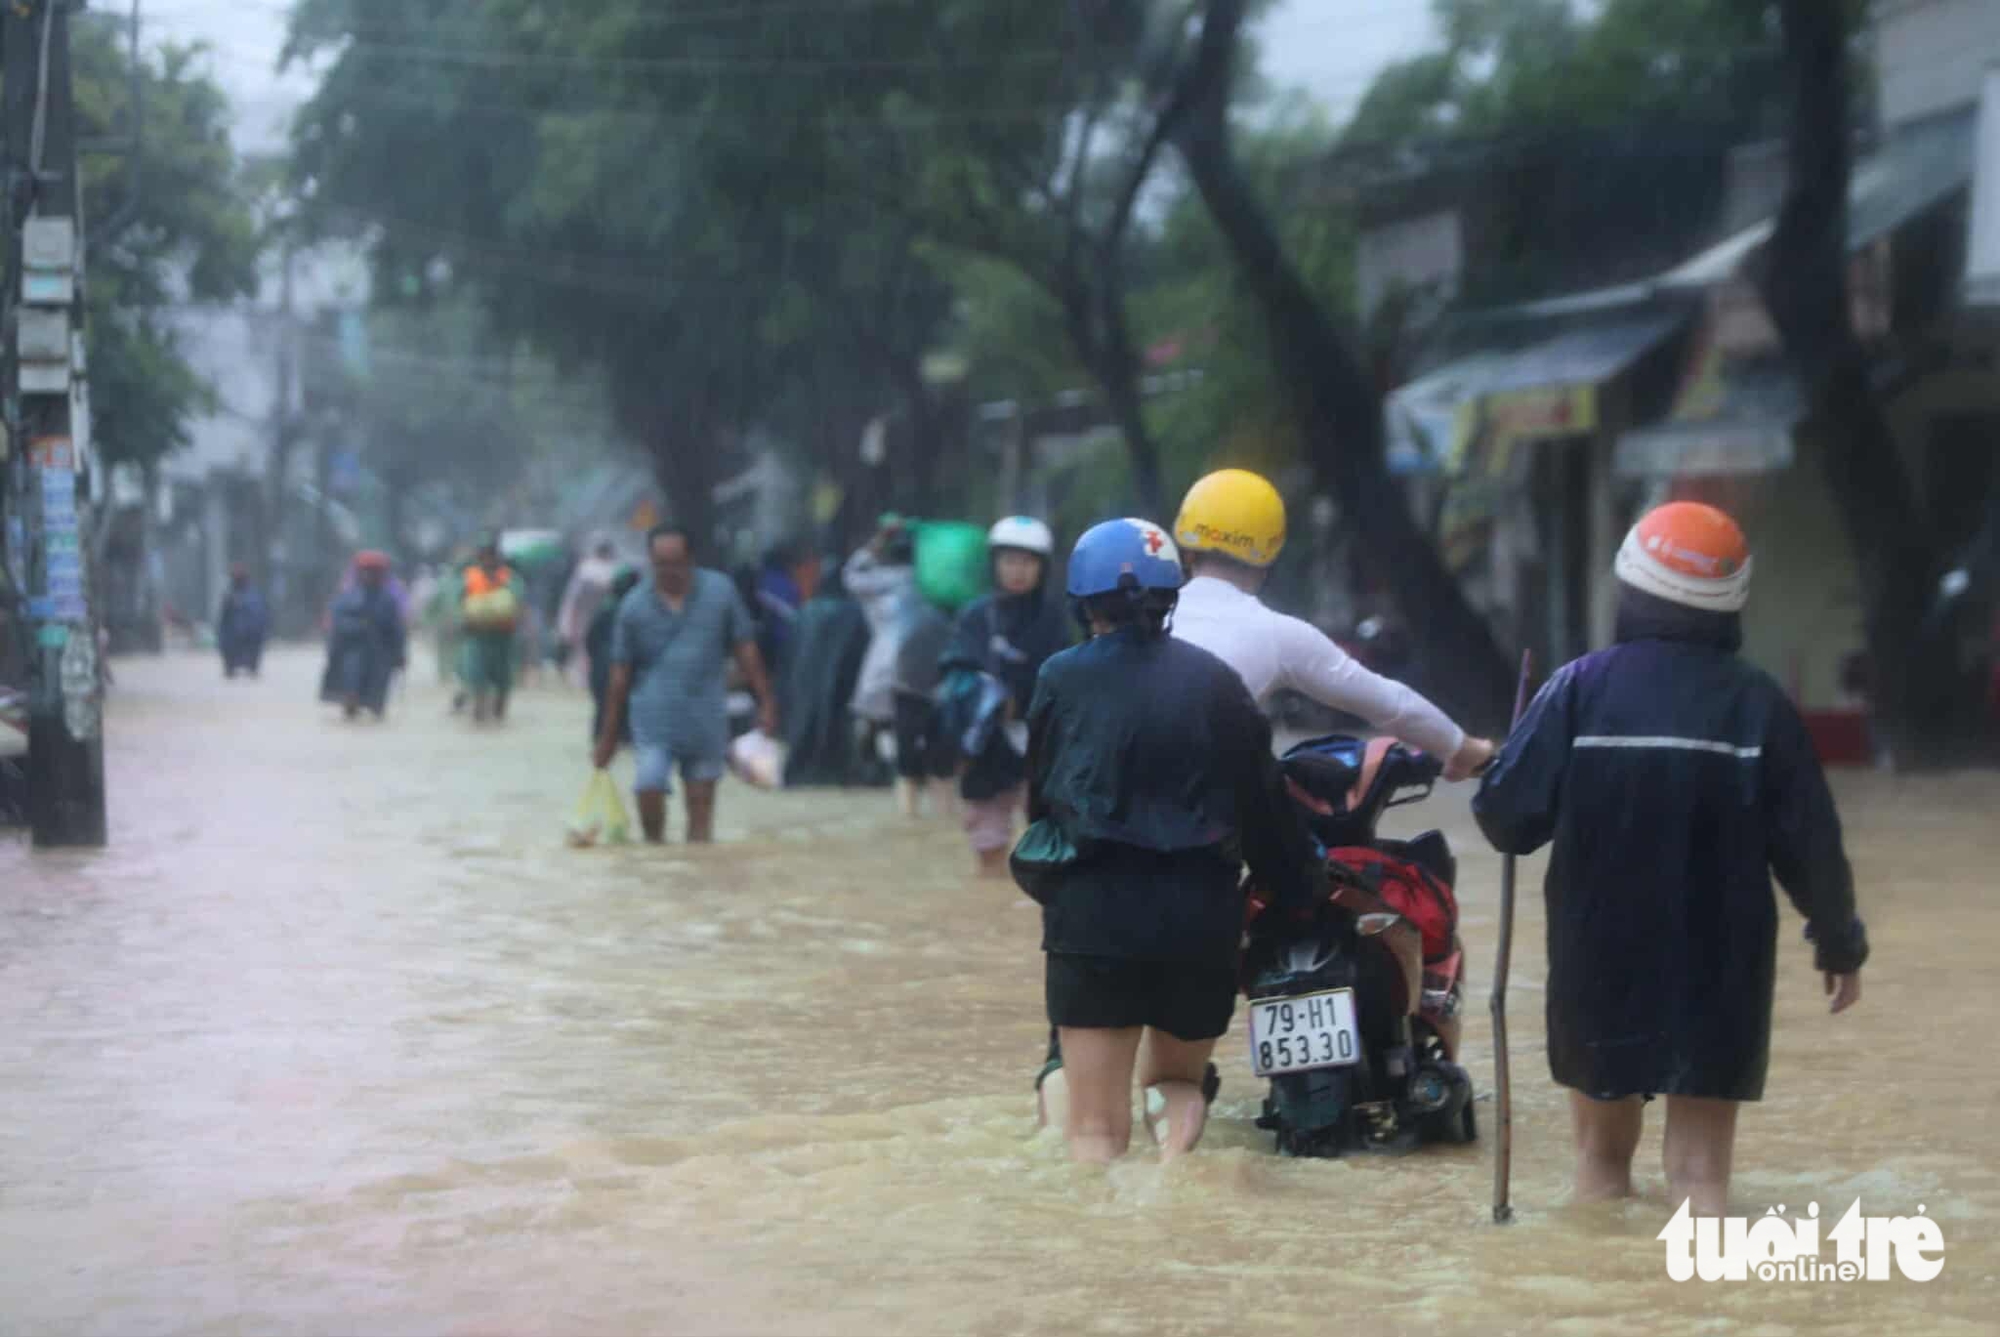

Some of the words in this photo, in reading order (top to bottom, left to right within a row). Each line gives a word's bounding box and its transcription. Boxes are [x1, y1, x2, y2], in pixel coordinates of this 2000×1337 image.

[1195, 523, 1255, 547] maxim
[1264, 997, 1336, 1036] 79-H1
[1259, 1029, 1352, 1070] 853.30
